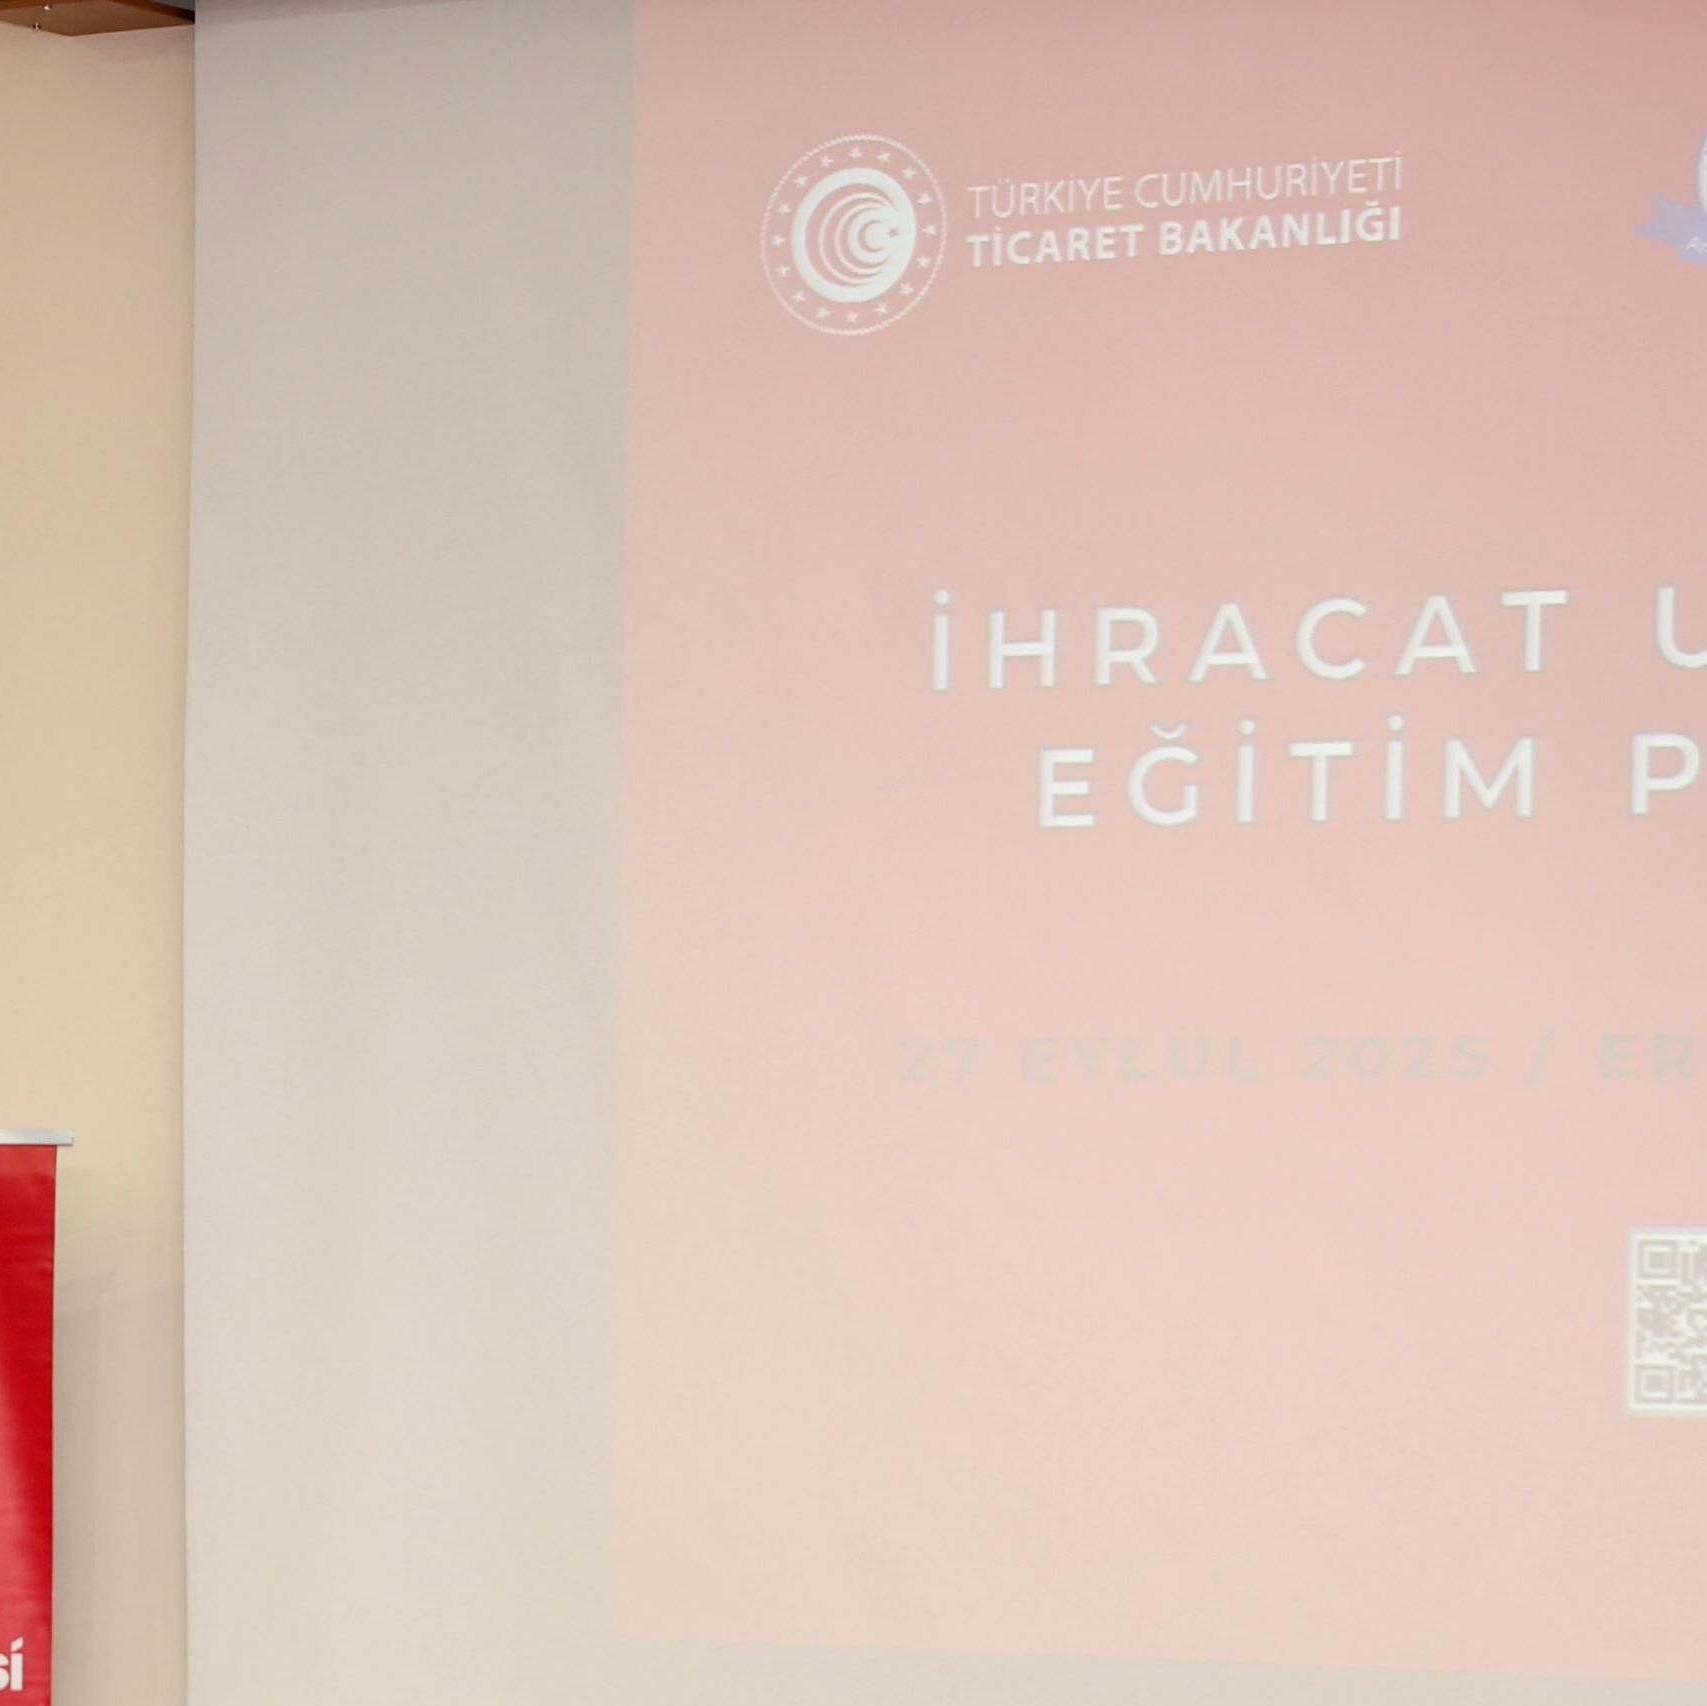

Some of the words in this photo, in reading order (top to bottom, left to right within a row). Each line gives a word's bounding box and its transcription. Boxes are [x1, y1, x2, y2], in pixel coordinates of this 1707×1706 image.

[966, 173, 1124, 219] TÜRKİYE
[1133, 151, 1403, 208] CUMHURİYETİ
[966, 226, 1145, 267] TİCARET
[1158, 200, 1402, 256] BAKANLIĞI
[932, 588, 1570, 691] İHRACAT
[1038, 714, 1535, 827] EĞİTİM
[1632, 732, 1701, 815] P
[1019, 1025, 1261, 1084] EYLÜL
[1303, 1033, 1486, 1083] 2025
